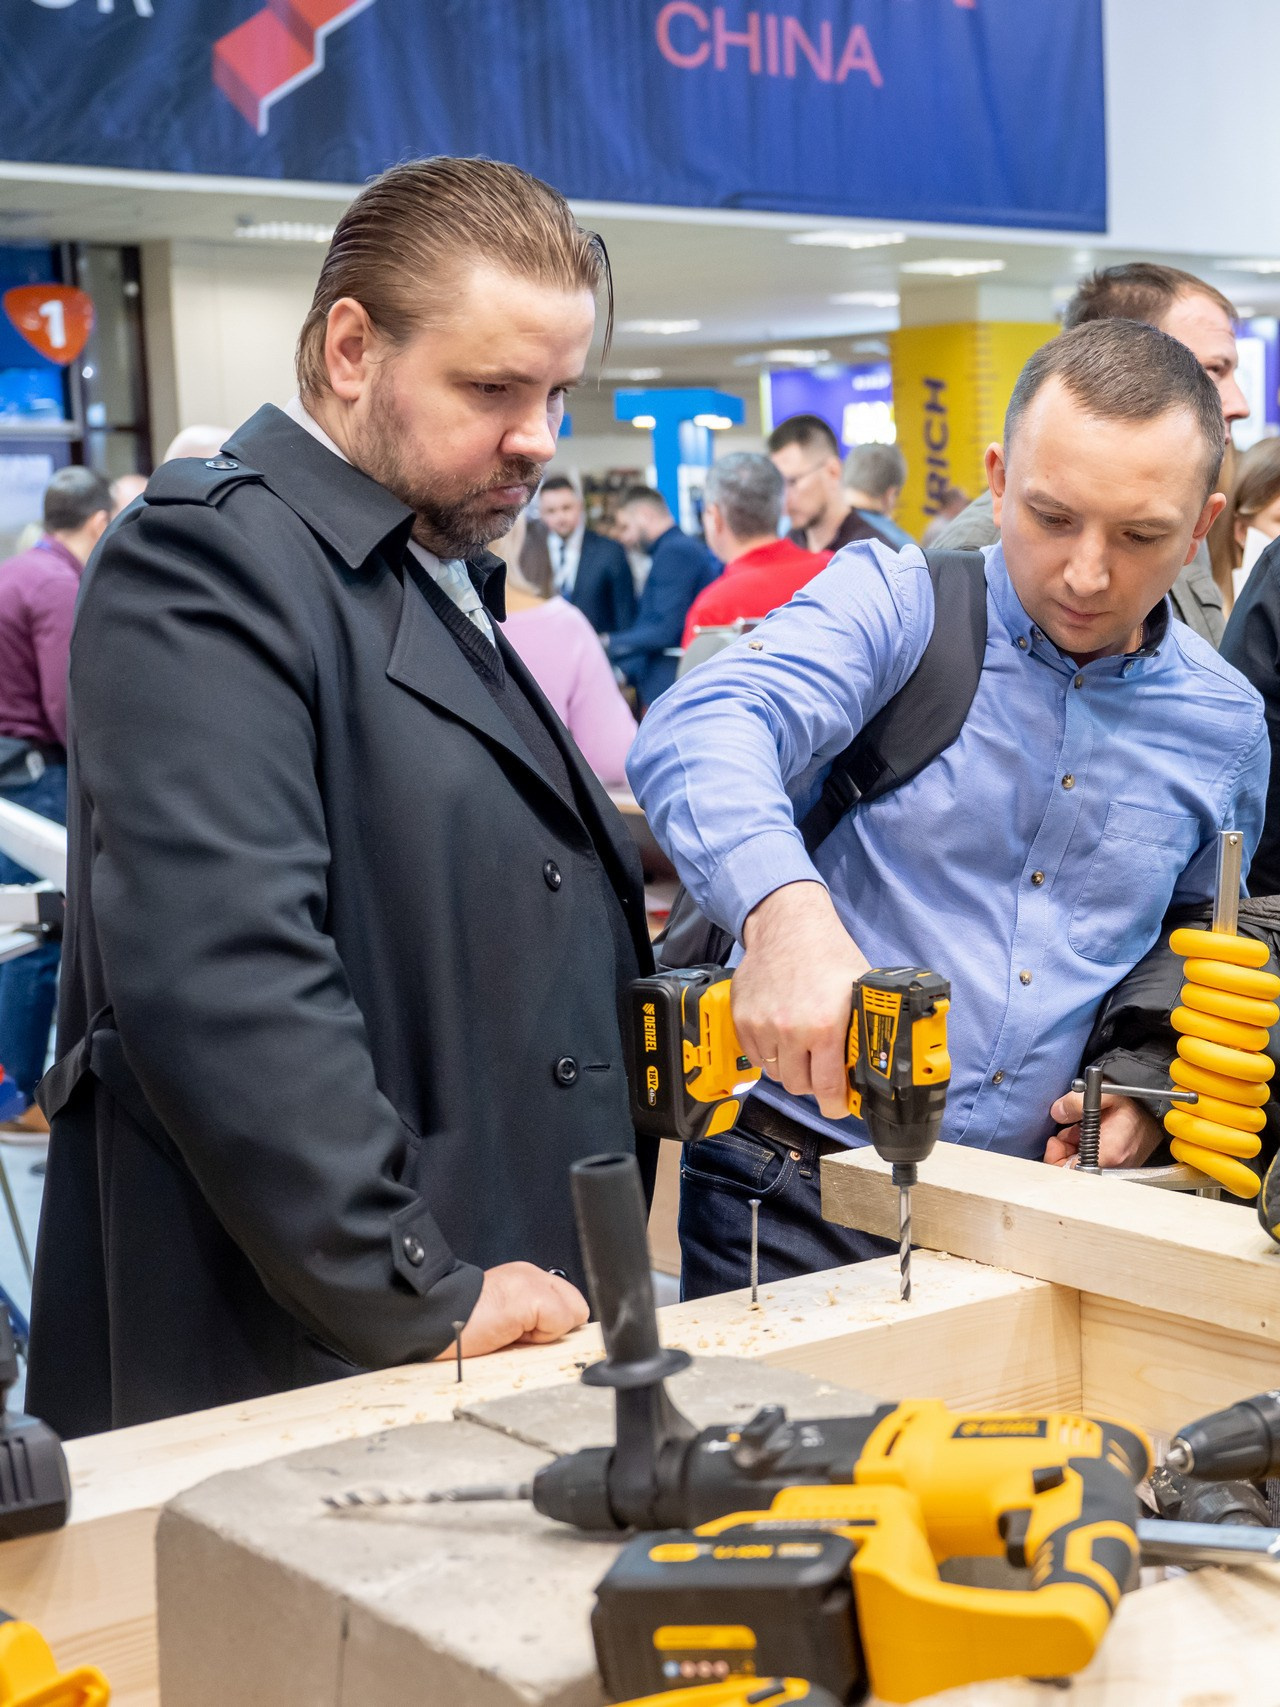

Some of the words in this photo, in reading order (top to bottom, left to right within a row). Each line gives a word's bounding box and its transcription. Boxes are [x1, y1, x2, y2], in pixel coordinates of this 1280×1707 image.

[655, 1, 883, 88] CHINA
[39, 299, 67, 348] 1
[644, 1016, 657, 1052] DENZEL
